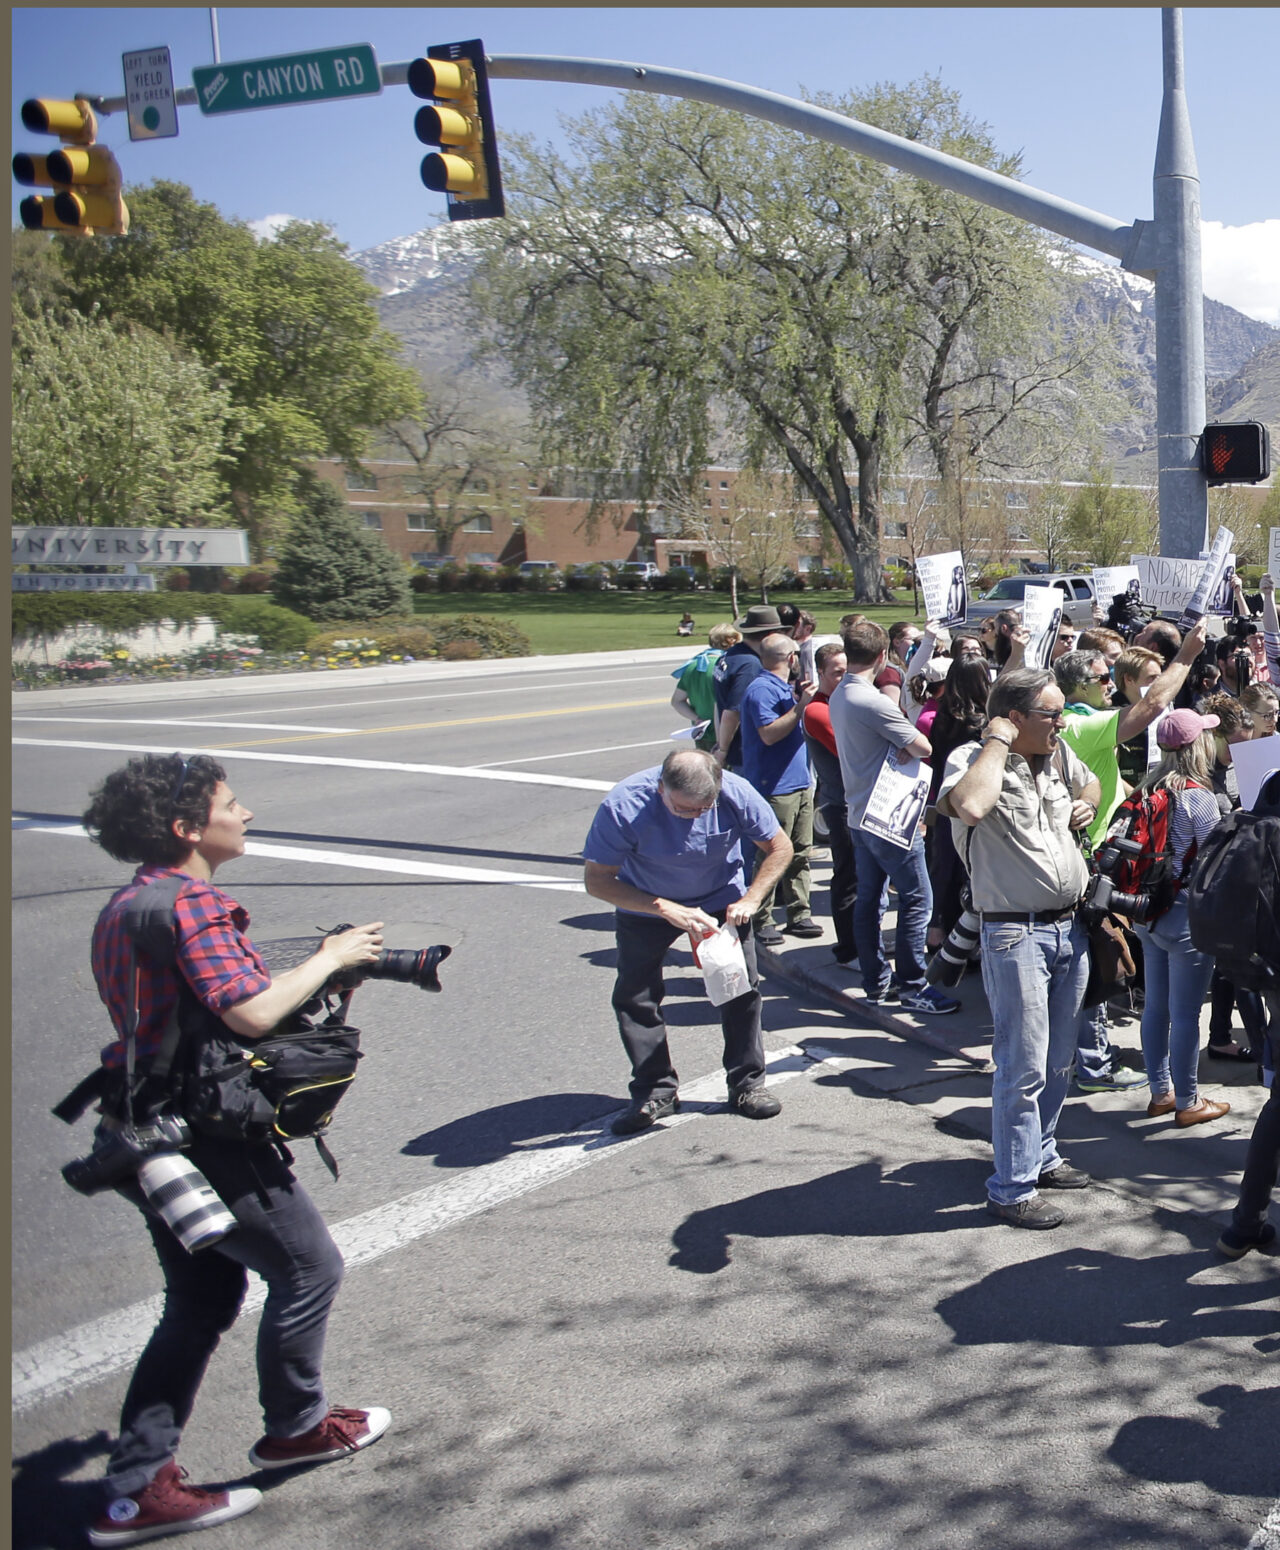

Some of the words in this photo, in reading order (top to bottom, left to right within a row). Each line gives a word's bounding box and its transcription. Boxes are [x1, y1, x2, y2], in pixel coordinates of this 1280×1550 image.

[134, 71, 163, 88] YIELD
[242, 61, 325, 100] CANYON
[334, 56, 365, 88] RD
[130, 92, 142, 104] ON
[144, 89, 171, 101] GREEN
[52, 577, 76, 587] TO
[84, 577, 141, 588] SERVE
[1173, 560, 1204, 589] RAPE
